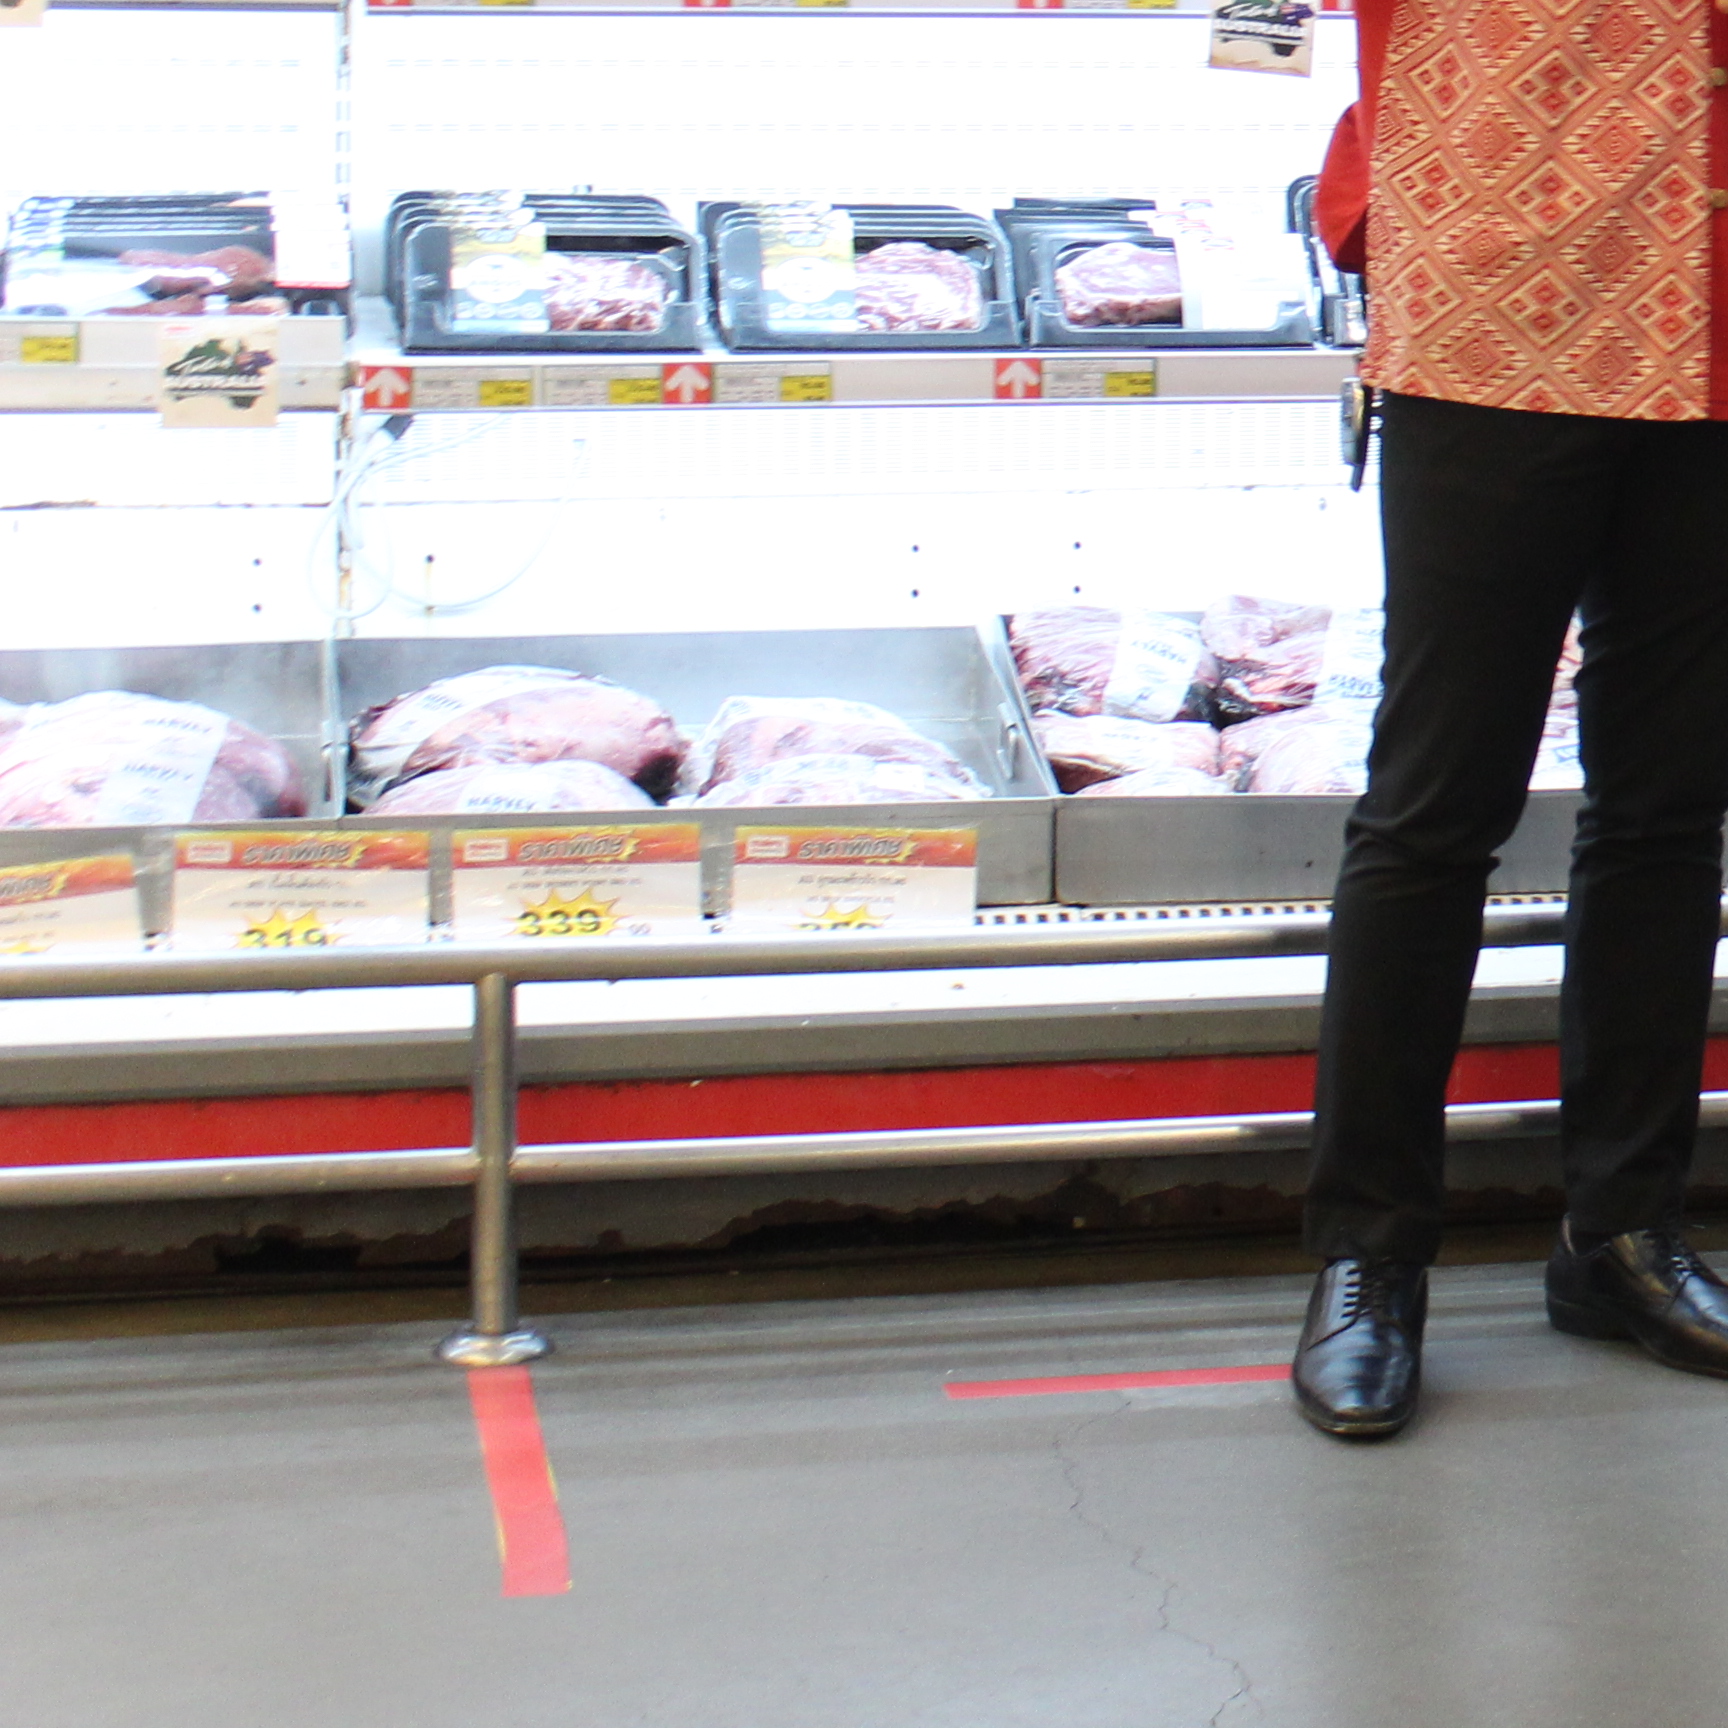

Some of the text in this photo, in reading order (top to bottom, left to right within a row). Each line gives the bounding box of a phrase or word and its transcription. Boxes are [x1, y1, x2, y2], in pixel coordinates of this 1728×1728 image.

[123, 763, 193, 782] HARVEY
[466, 795, 537, 812] HARVEY
[242, 839, 352, 865] ราคาพิเศษ
[517, 834, 626, 861] ราคาพิเศษ
[800, 833, 905, 859] ราคาพิเศษ
